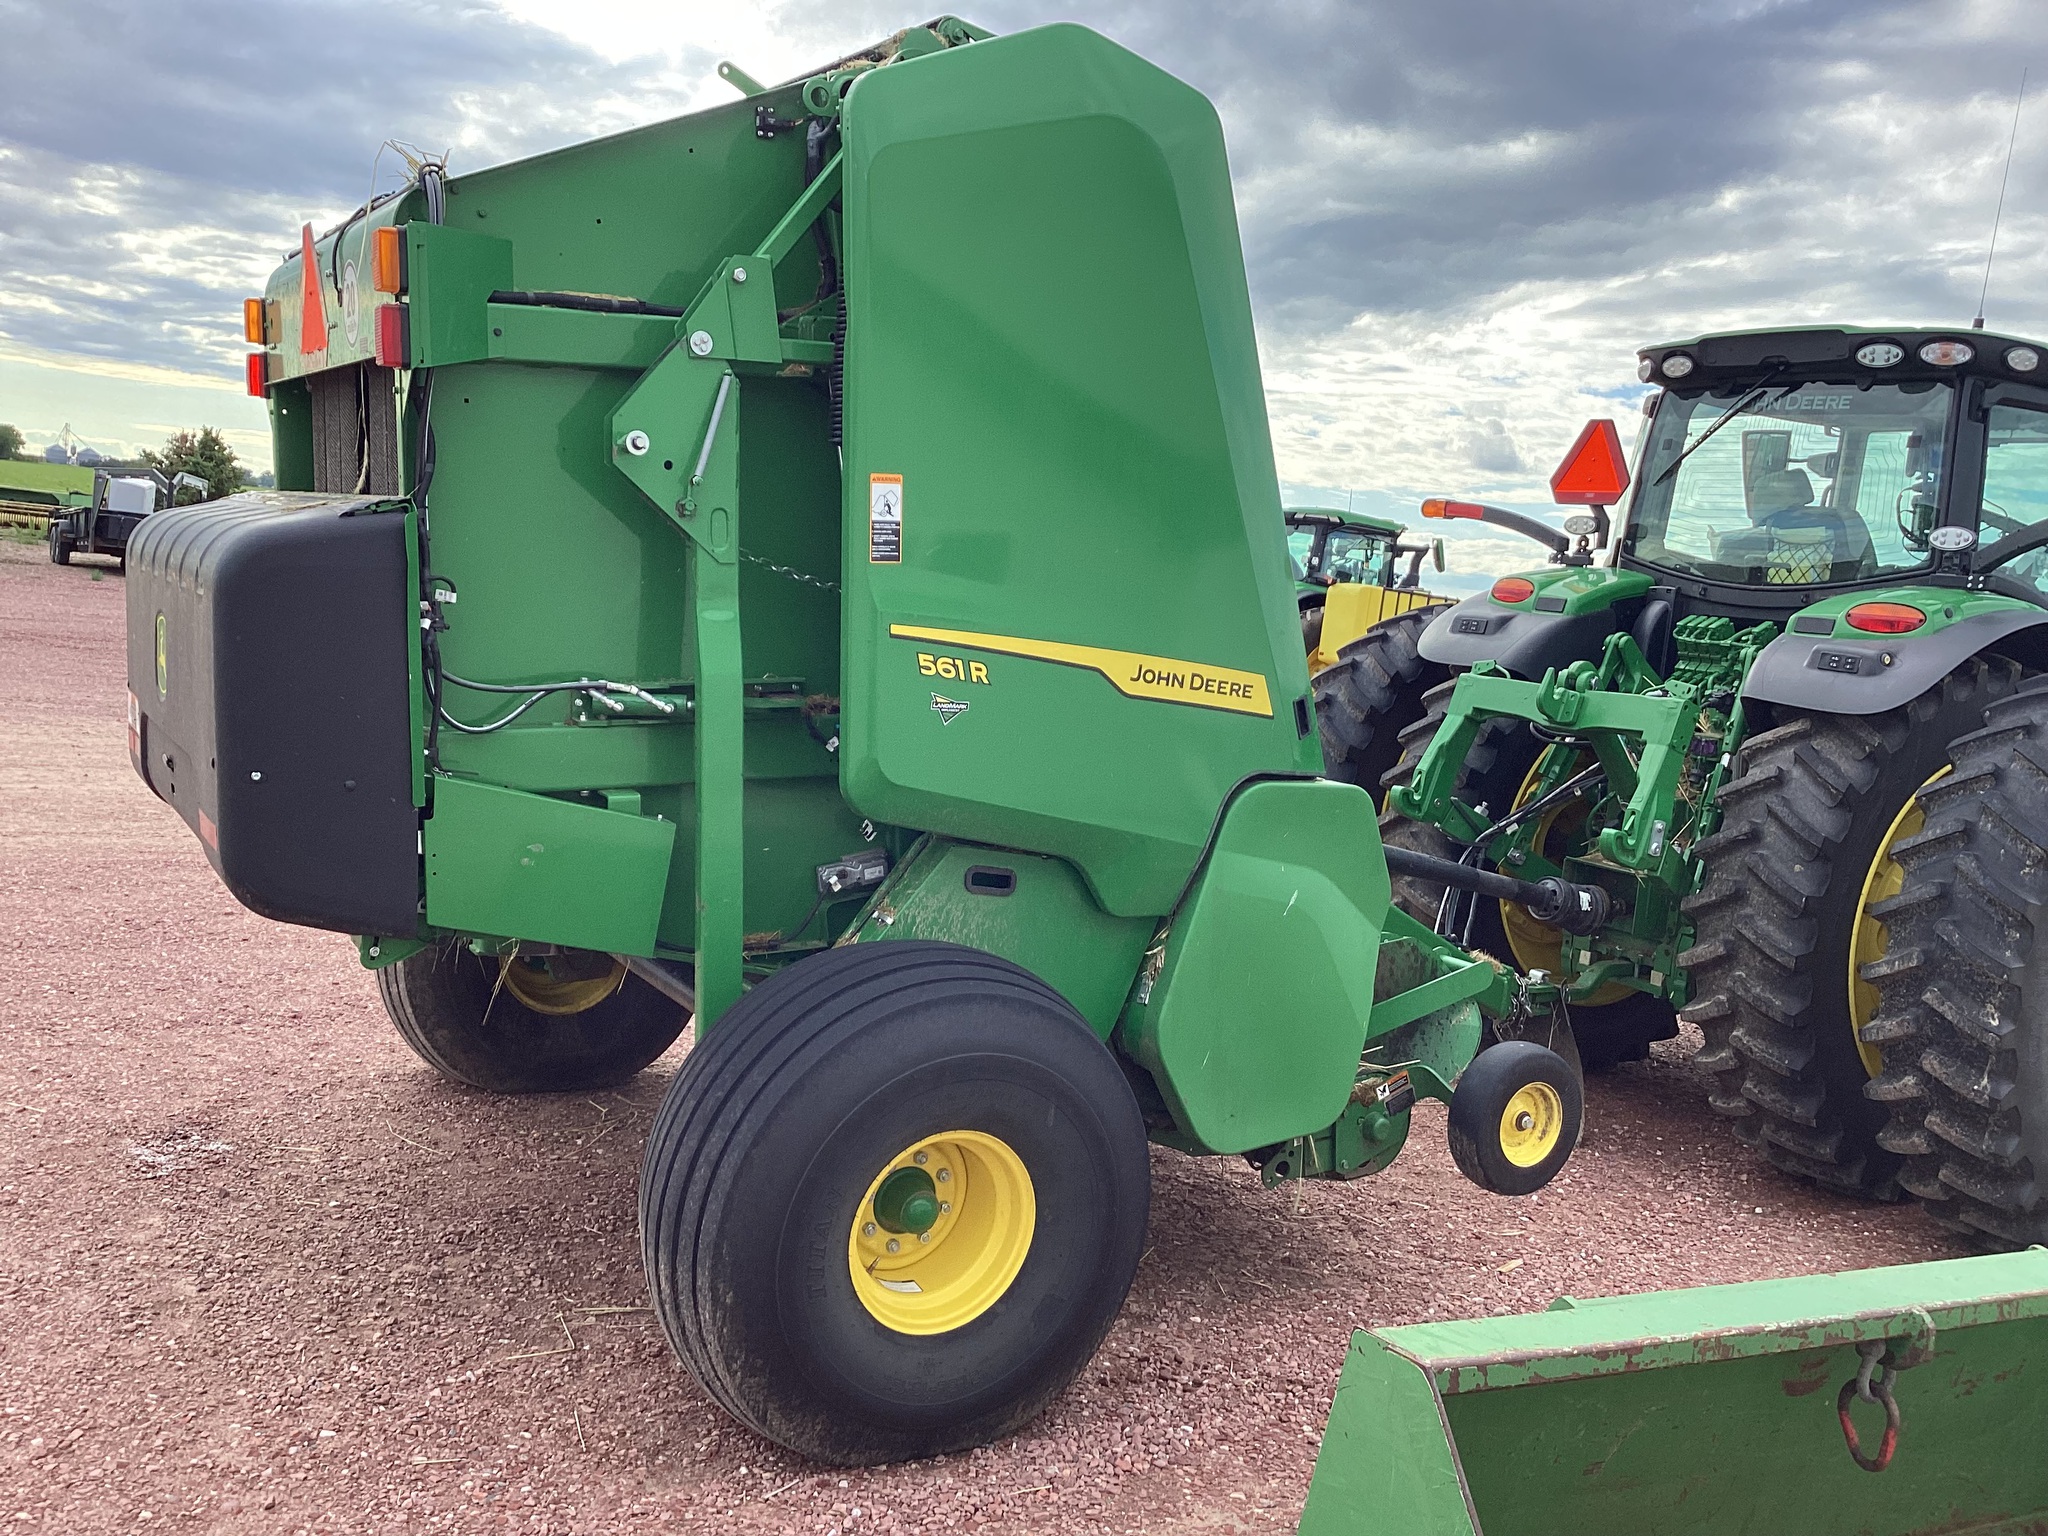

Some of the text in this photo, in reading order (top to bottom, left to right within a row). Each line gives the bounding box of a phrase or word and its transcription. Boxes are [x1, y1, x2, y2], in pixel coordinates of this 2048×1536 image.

[1785, 393, 1853, 411] DEERE
[1130, 664, 1254, 699] JOHN DEERE
[805, 1186, 844, 1301] TITAN
